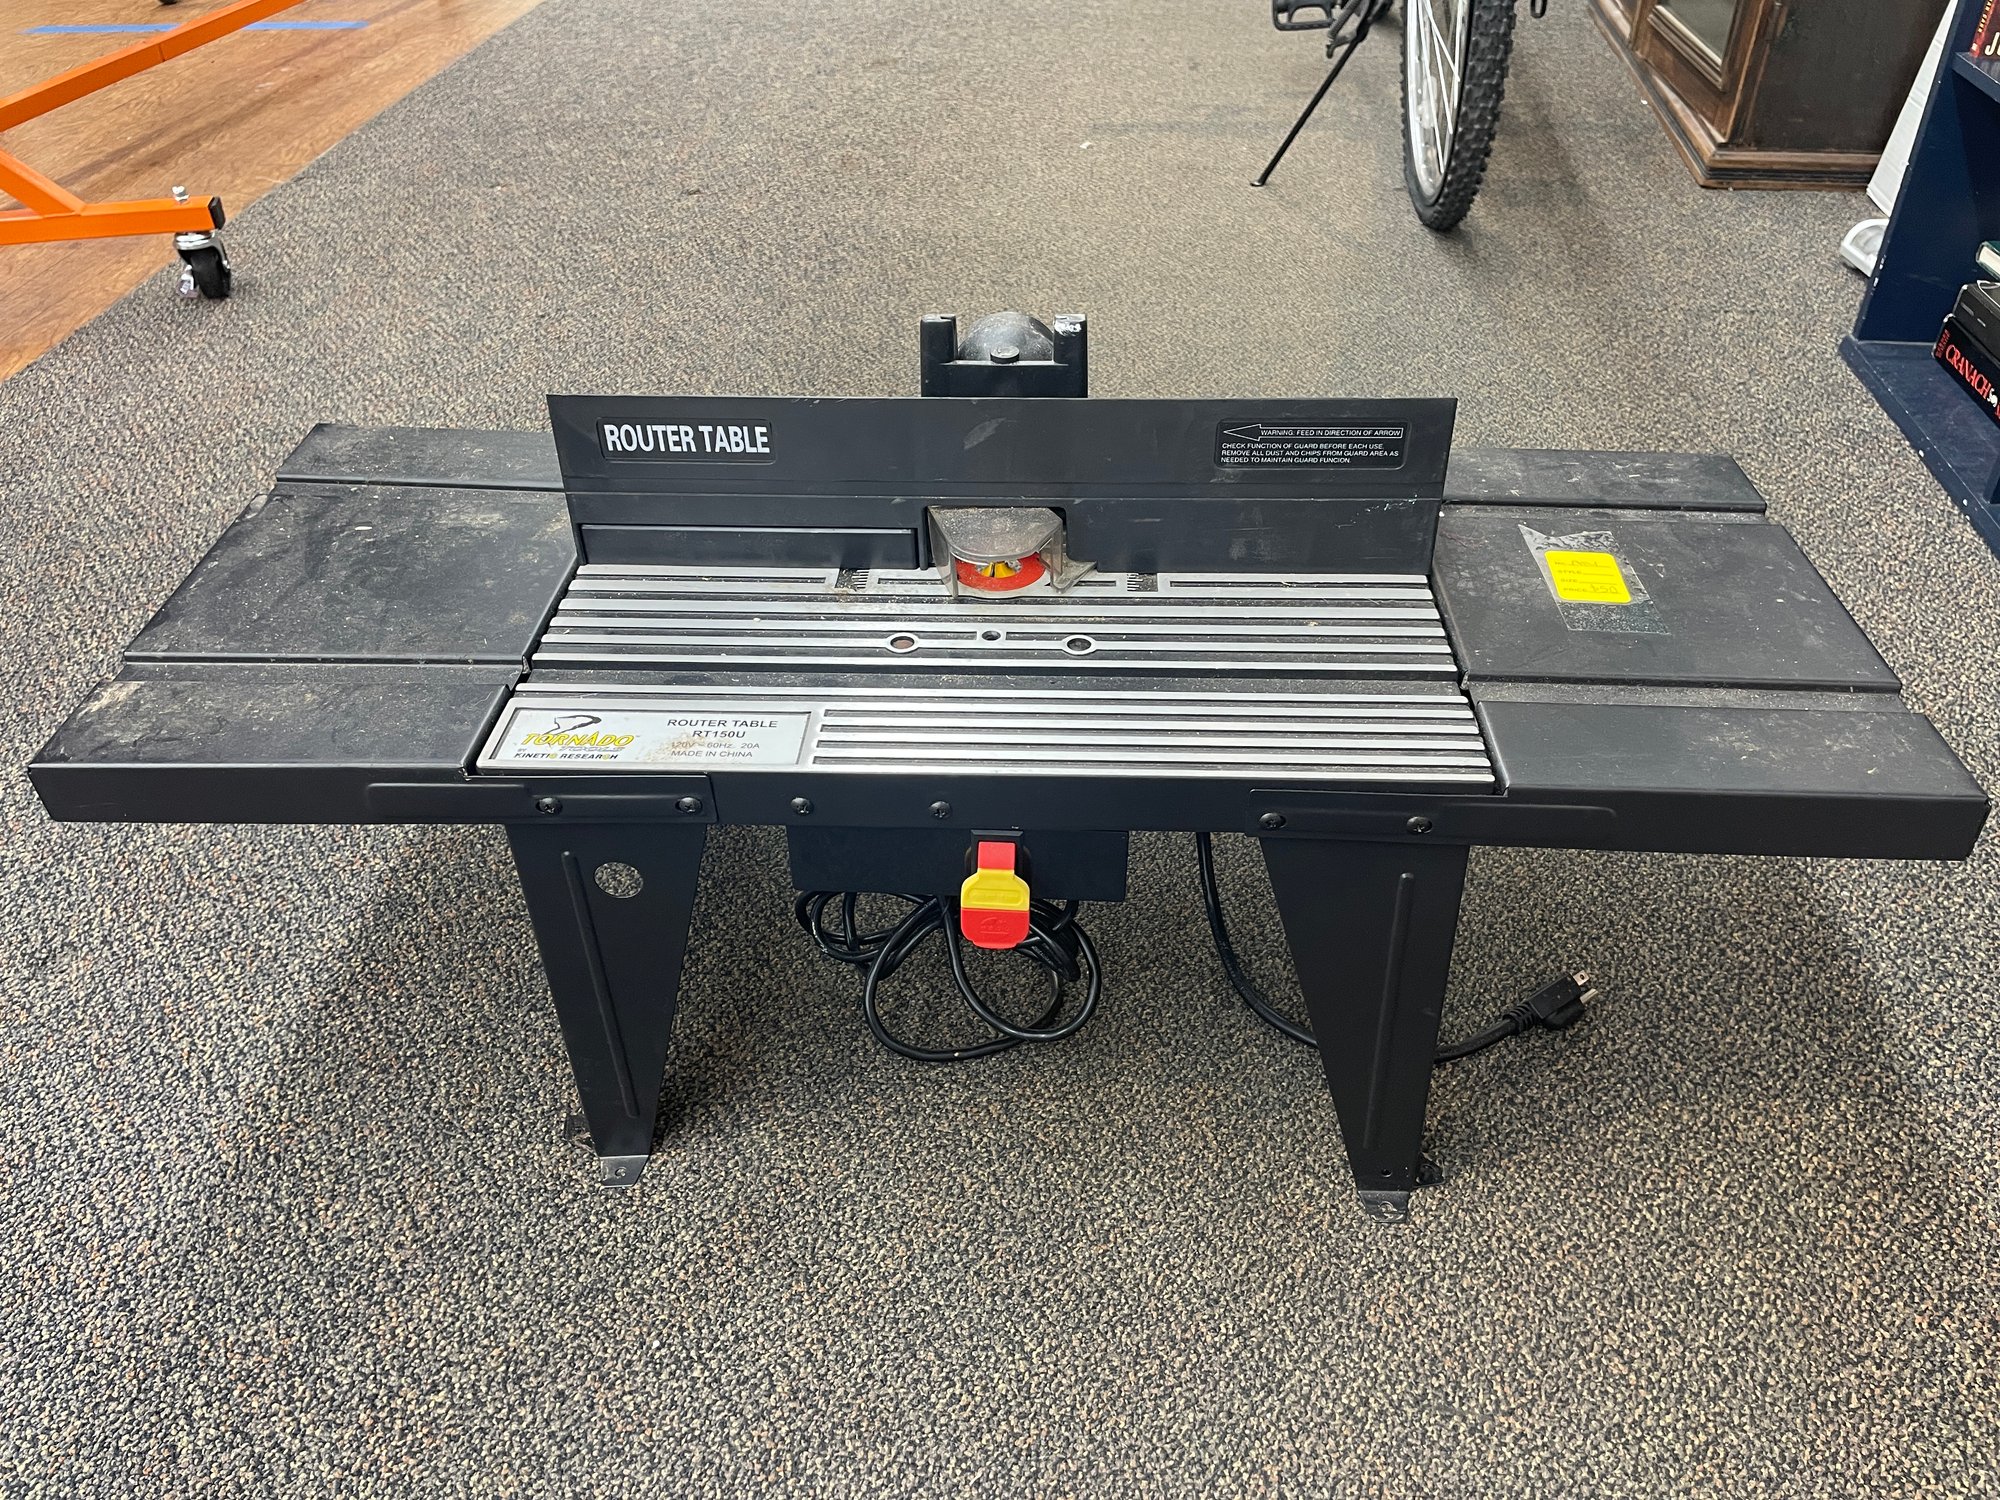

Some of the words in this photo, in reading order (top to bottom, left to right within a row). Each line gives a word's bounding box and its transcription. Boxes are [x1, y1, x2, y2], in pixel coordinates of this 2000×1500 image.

[1945, 344, 1992, 400] CRANACH
[603, 424, 697, 452] ROUTER
[698, 425, 771, 454] TABLE
[667, 719, 727, 727] ROUTER
[733, 720, 778, 728] TABLE
[521, 731, 635, 747] TORNADO
[693, 730, 746, 738] RT150U
